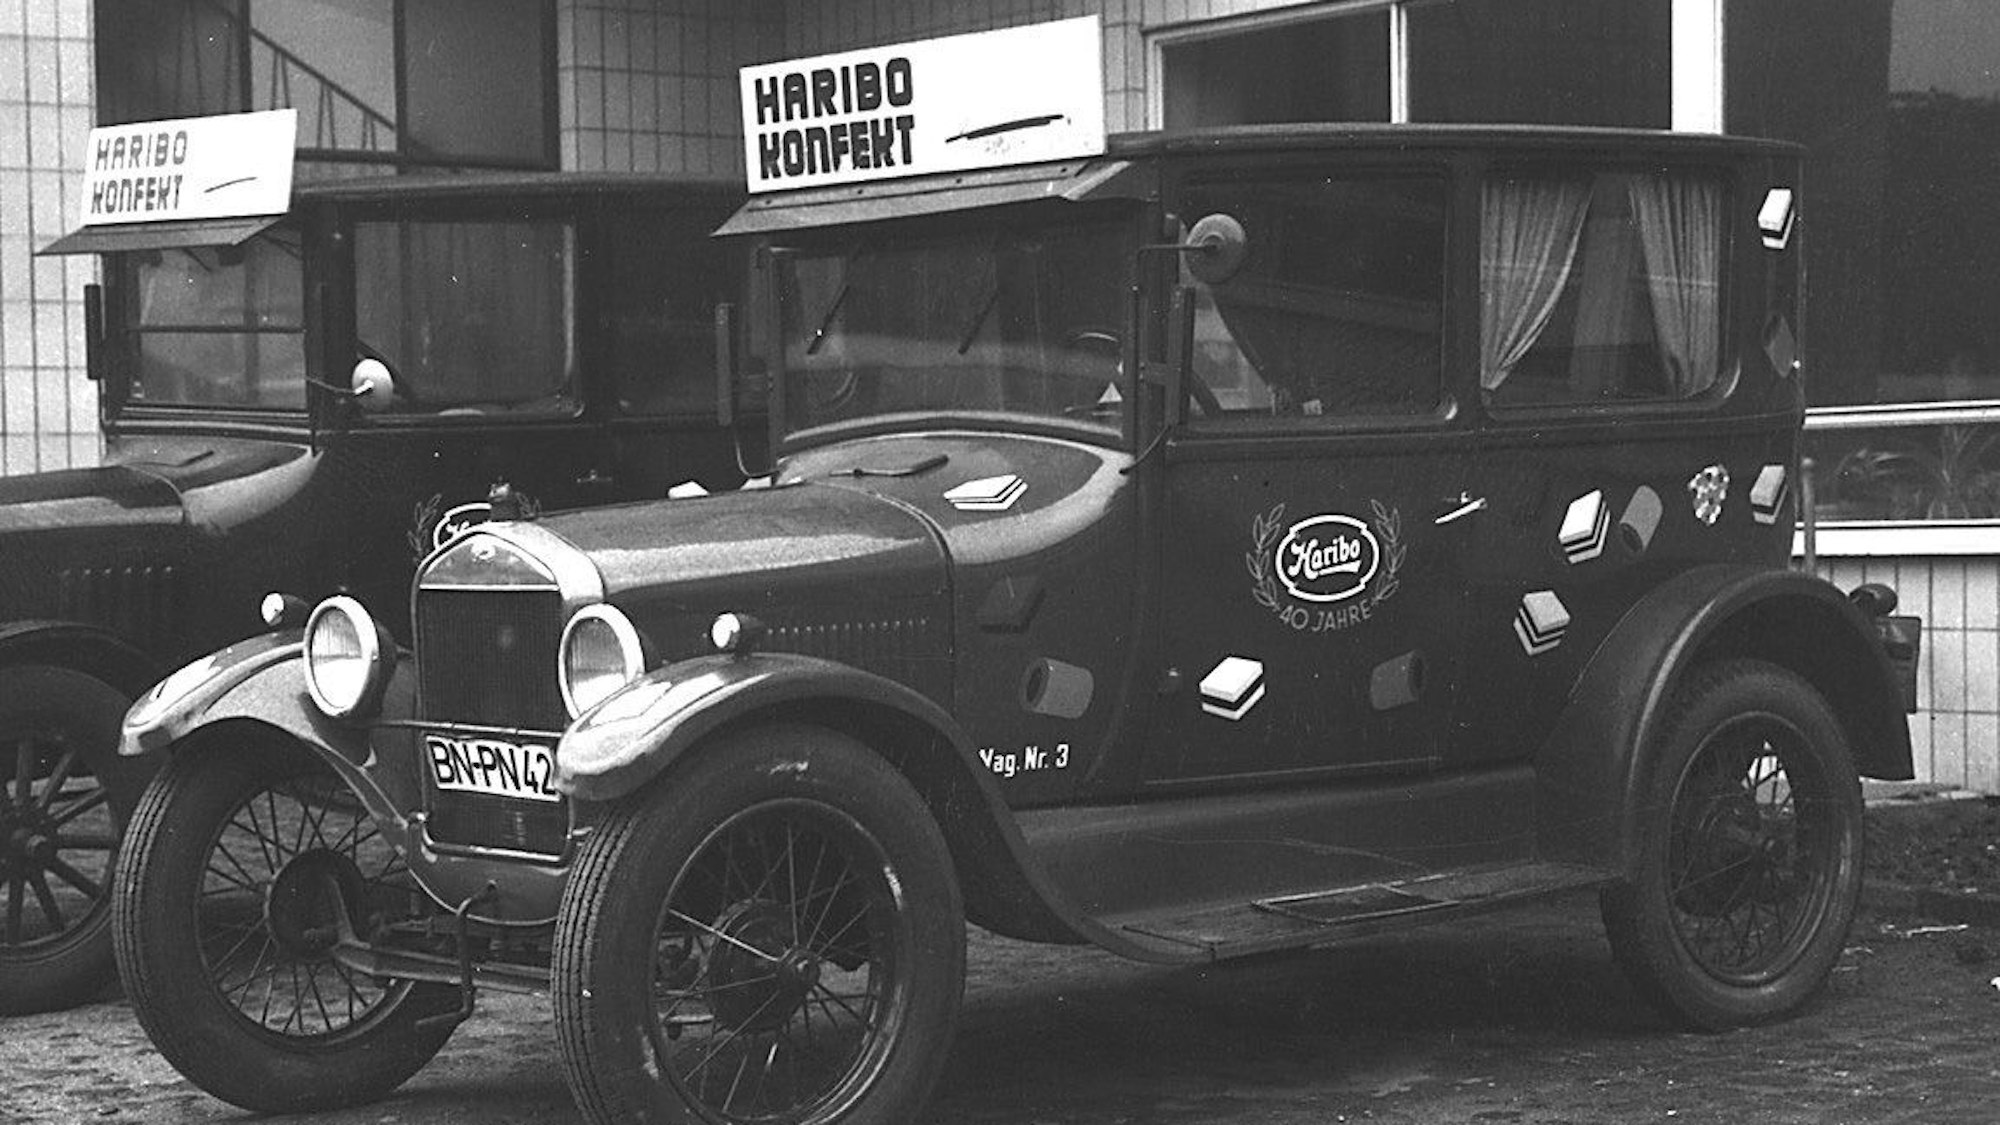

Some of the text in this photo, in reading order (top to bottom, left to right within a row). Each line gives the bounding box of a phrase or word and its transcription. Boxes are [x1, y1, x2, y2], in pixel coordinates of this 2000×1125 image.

[755, 57, 913, 125] HARIBO
[95, 130, 188, 171] HARIBO
[758, 114, 915, 180] KONFEKT
[91, 174, 183, 214] KONFEKT
[1287, 535, 1361, 580] Haribo
[1279, 599, 1372, 632] 40 JAHRE
[1024, 745, 1049, 770] Nr.
[1055, 743, 1069, 768] 3
